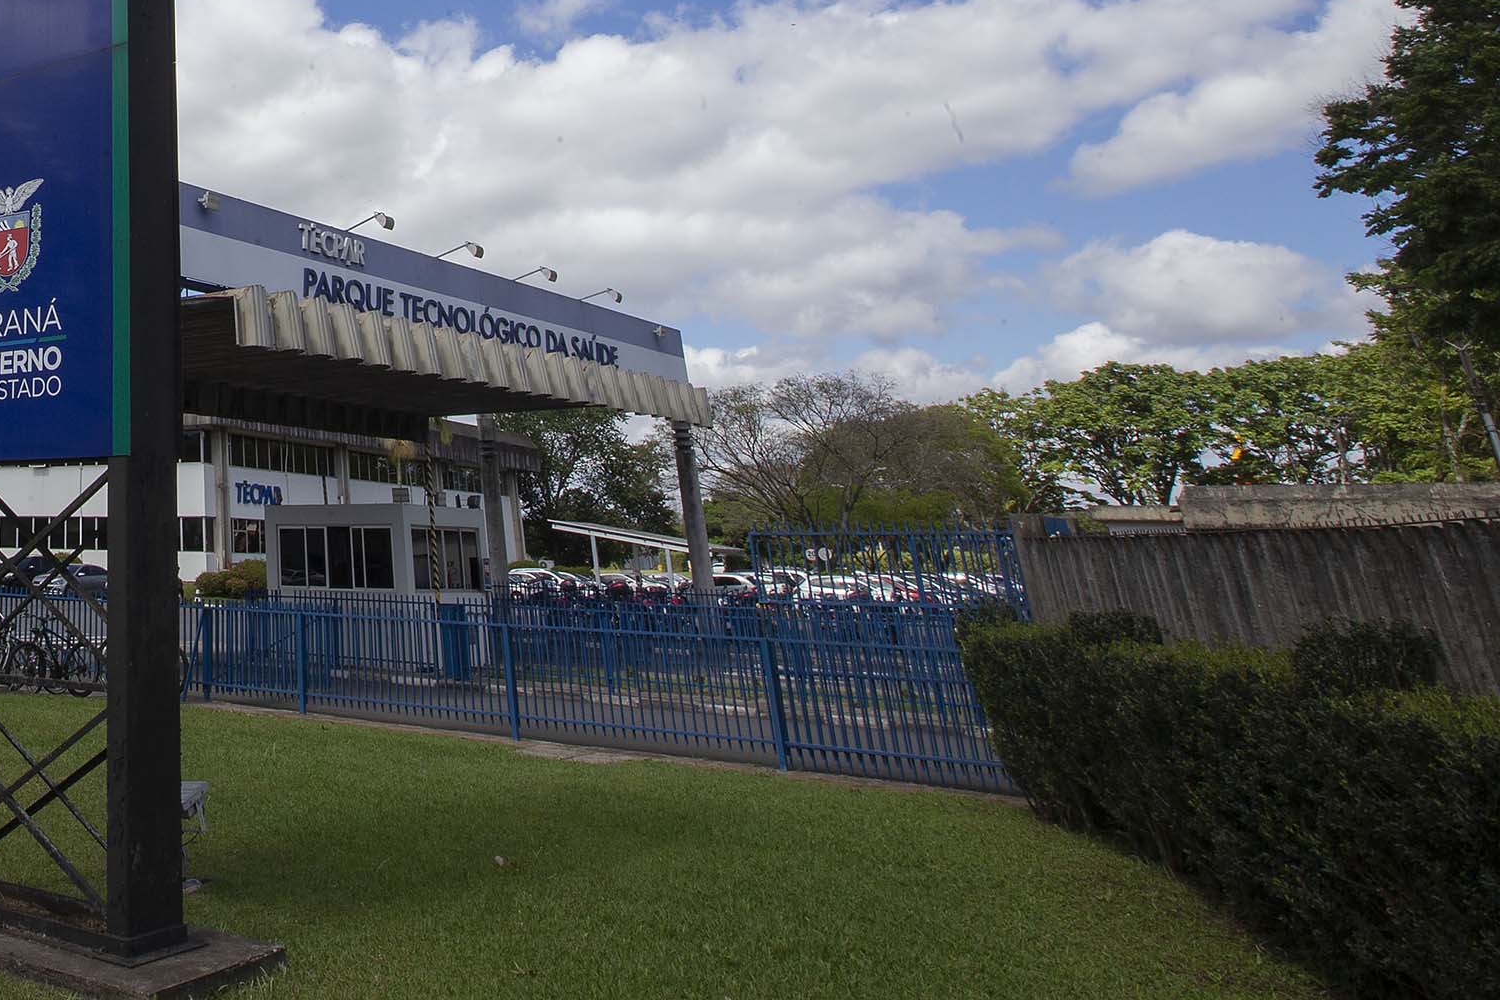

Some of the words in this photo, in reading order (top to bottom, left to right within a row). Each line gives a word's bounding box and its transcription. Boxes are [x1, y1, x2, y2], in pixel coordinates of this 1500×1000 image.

[298, 223, 366, 267] TECPAR
[303, 267, 395, 317] PARQUE
[399, 292, 542, 348] TECNOLÓGICO
[545, 329, 570, 358] DA
[571, 334, 619, 368] SAÚDE
